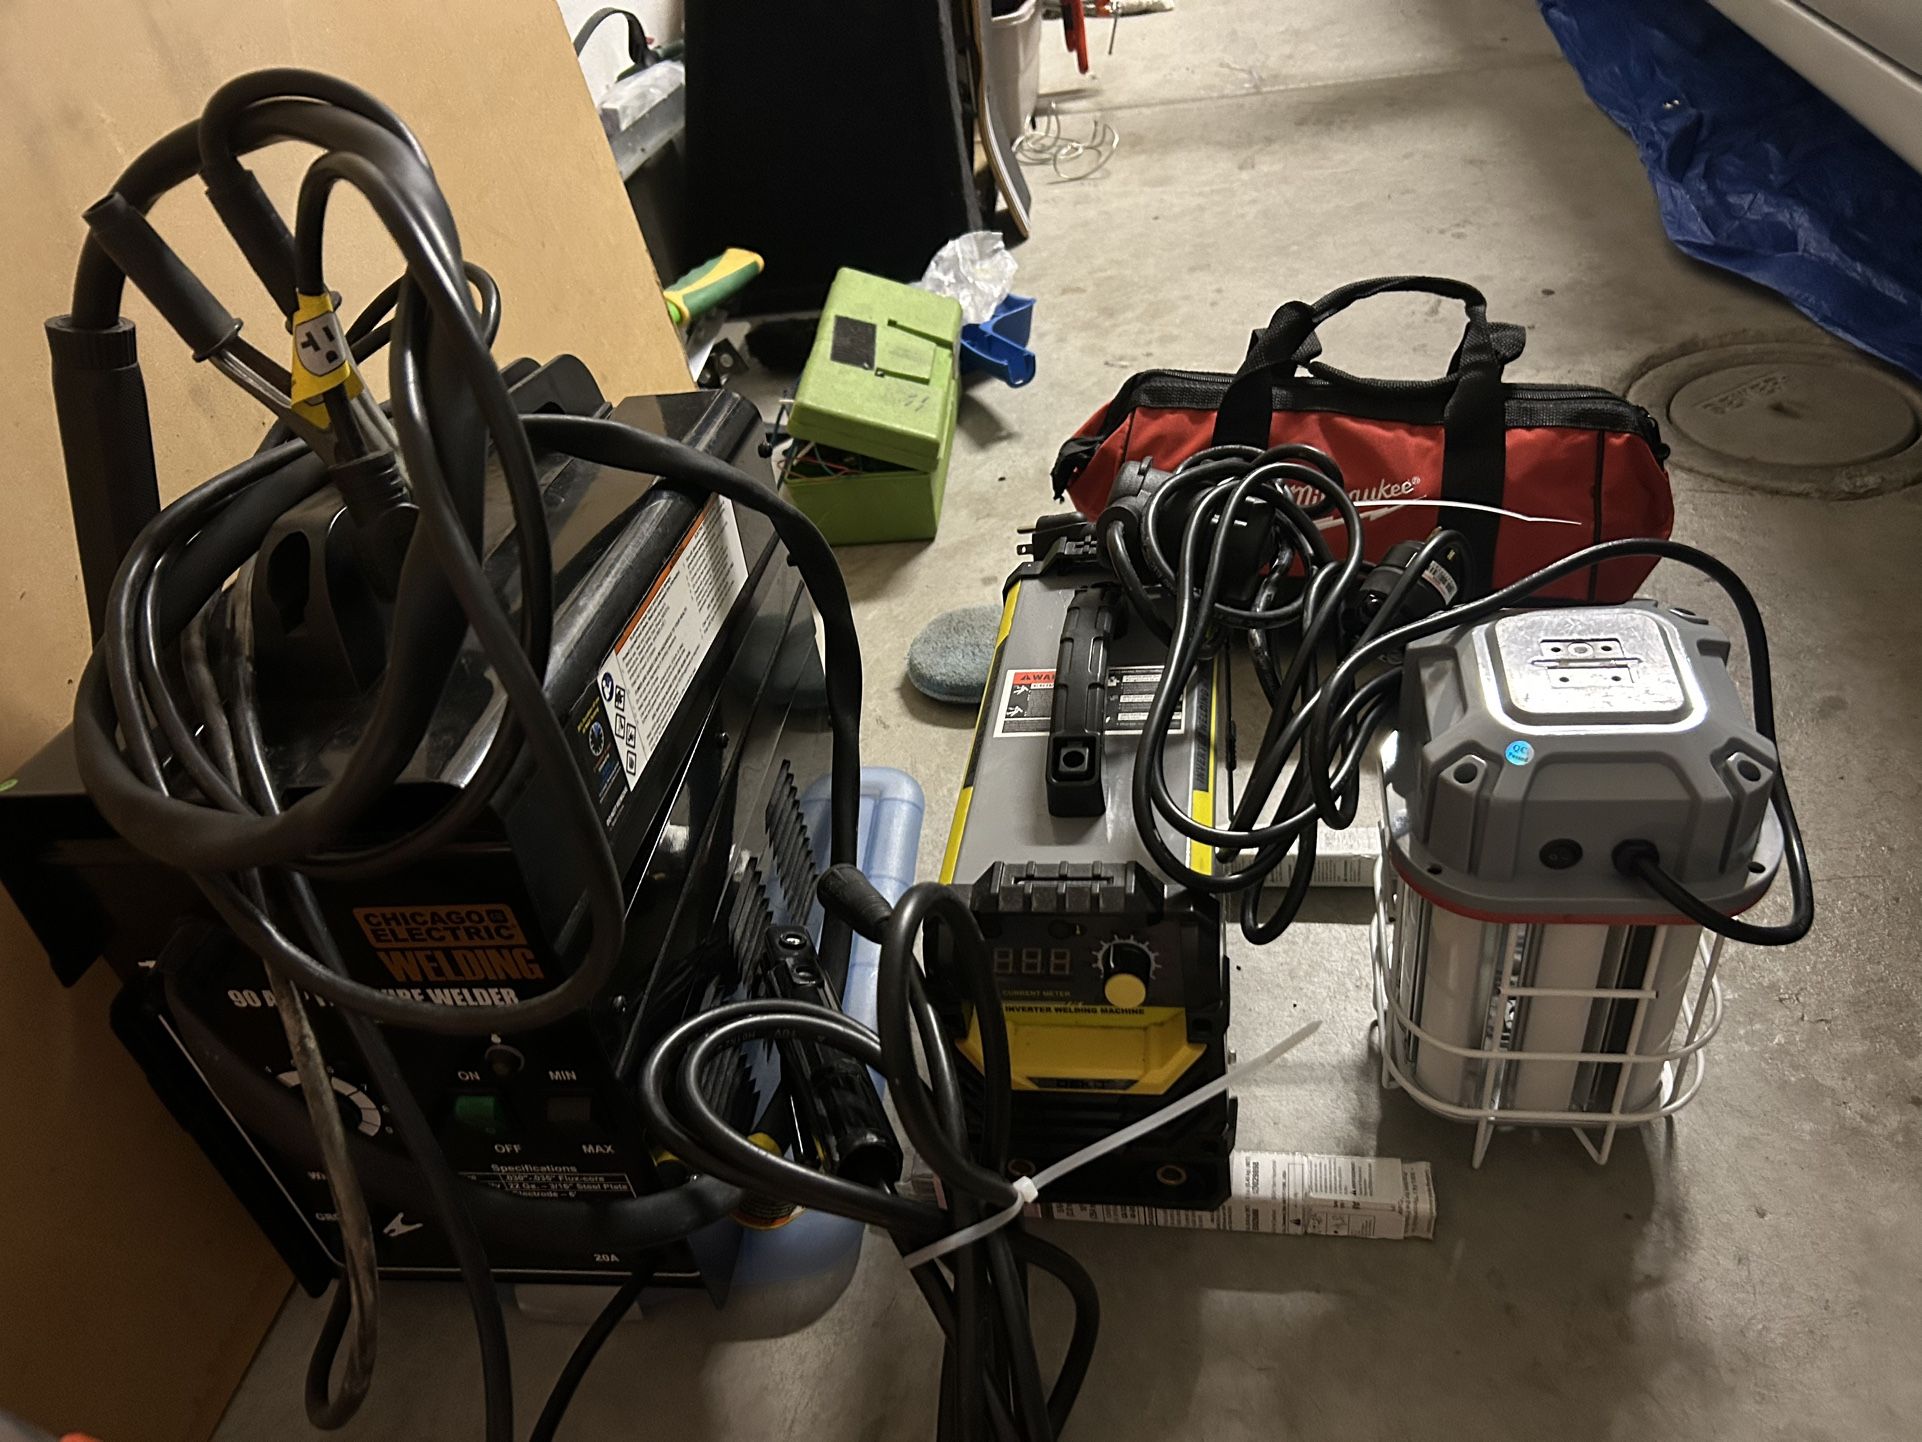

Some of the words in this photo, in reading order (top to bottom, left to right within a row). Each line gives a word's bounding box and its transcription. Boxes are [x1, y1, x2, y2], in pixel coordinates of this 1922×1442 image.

[1290, 477, 1415, 506] Miaukee
[1512, 744, 1528, 754] QC
[363, 909, 484, 927] CHICAGO
[370, 925, 516, 943] ELECTRIC
[376, 947, 545, 982] WELDING
[226, 989, 262, 1008] 90
[426, 986, 520, 1007] WELDER
[1002, 989, 1041, 998] CURRENT
[1043, 990, 1071, 998] METER
[1005, 1005, 1053, 1014] INVERTER
[1054, 1006, 1098, 1014] WELDING
[1100, 1006, 1145, 1015] MACHINE
[457, 1070, 481, 1081] ON
[548, 1070, 577, 1081] MIN
[494, 1143, 522, 1154] OFF
[582, 1144, 615, 1154] MAX
[491, 1163, 577, 1174] Specifications
[593, 1252, 620, 1264] 20A
